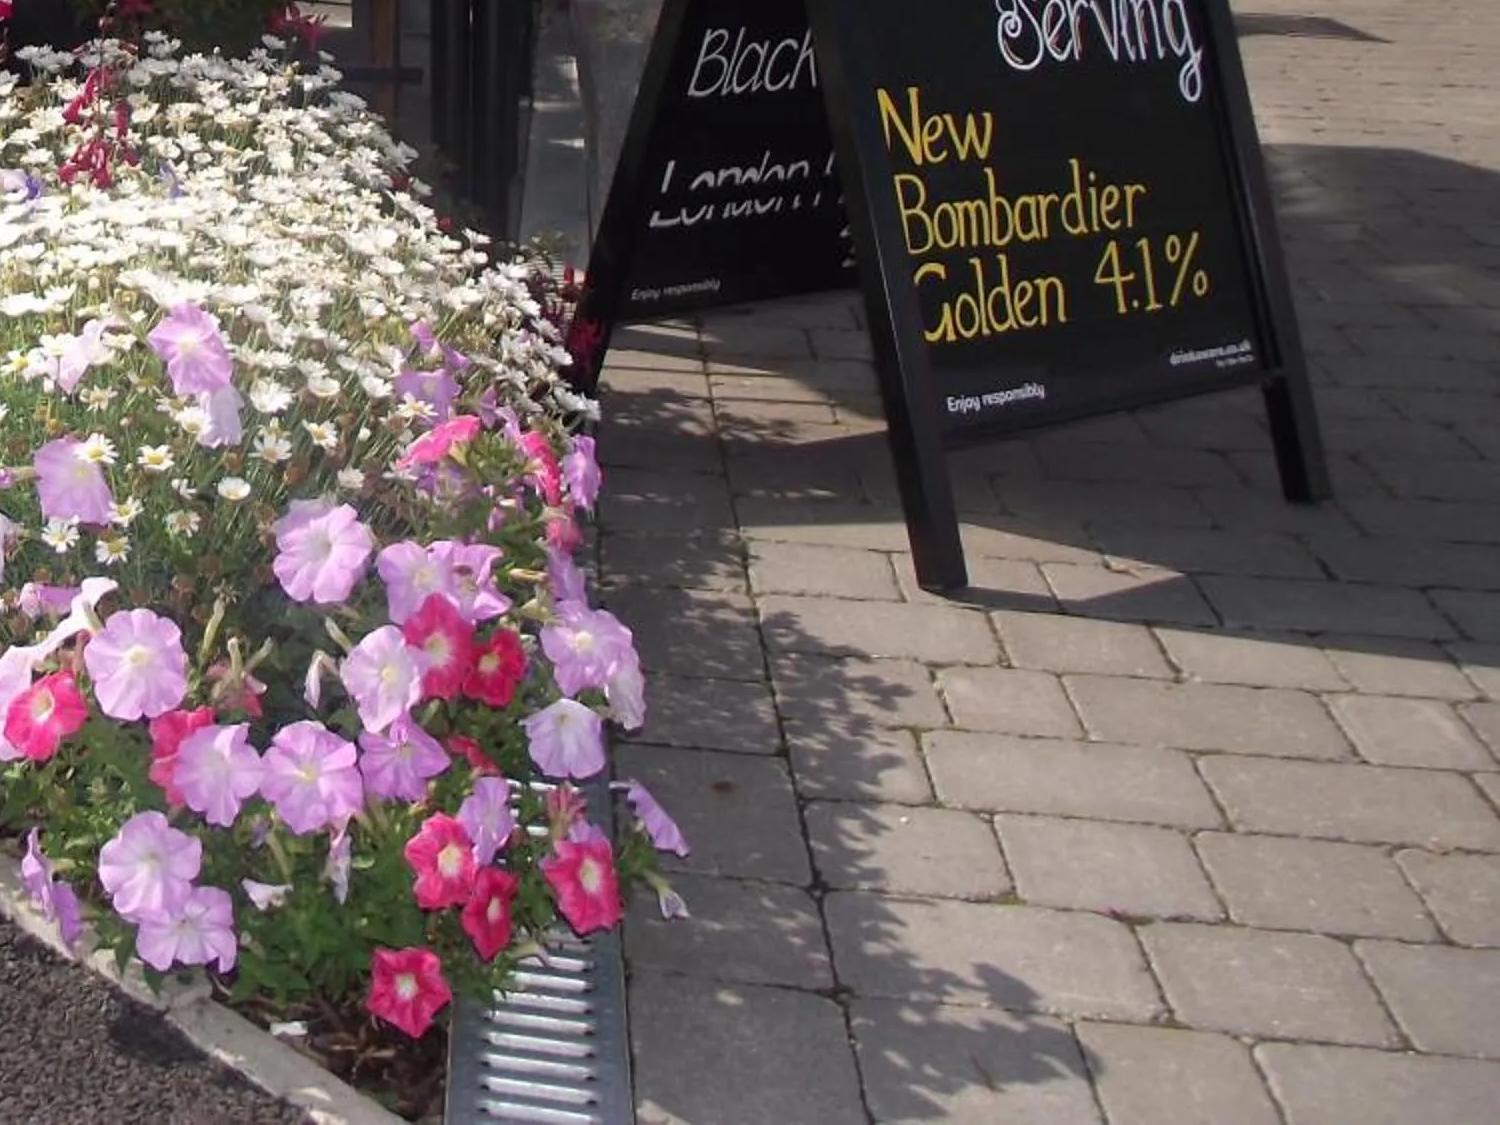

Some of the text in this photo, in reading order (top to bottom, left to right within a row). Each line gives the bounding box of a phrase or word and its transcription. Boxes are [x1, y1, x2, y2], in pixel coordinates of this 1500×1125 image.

[875, 86, 993, 166] New
[893, 157, 1147, 256] Bombardier
[912, 253, 1067, 342] Golden
[946, 382, 1045, 414] Enjoy responsibly
